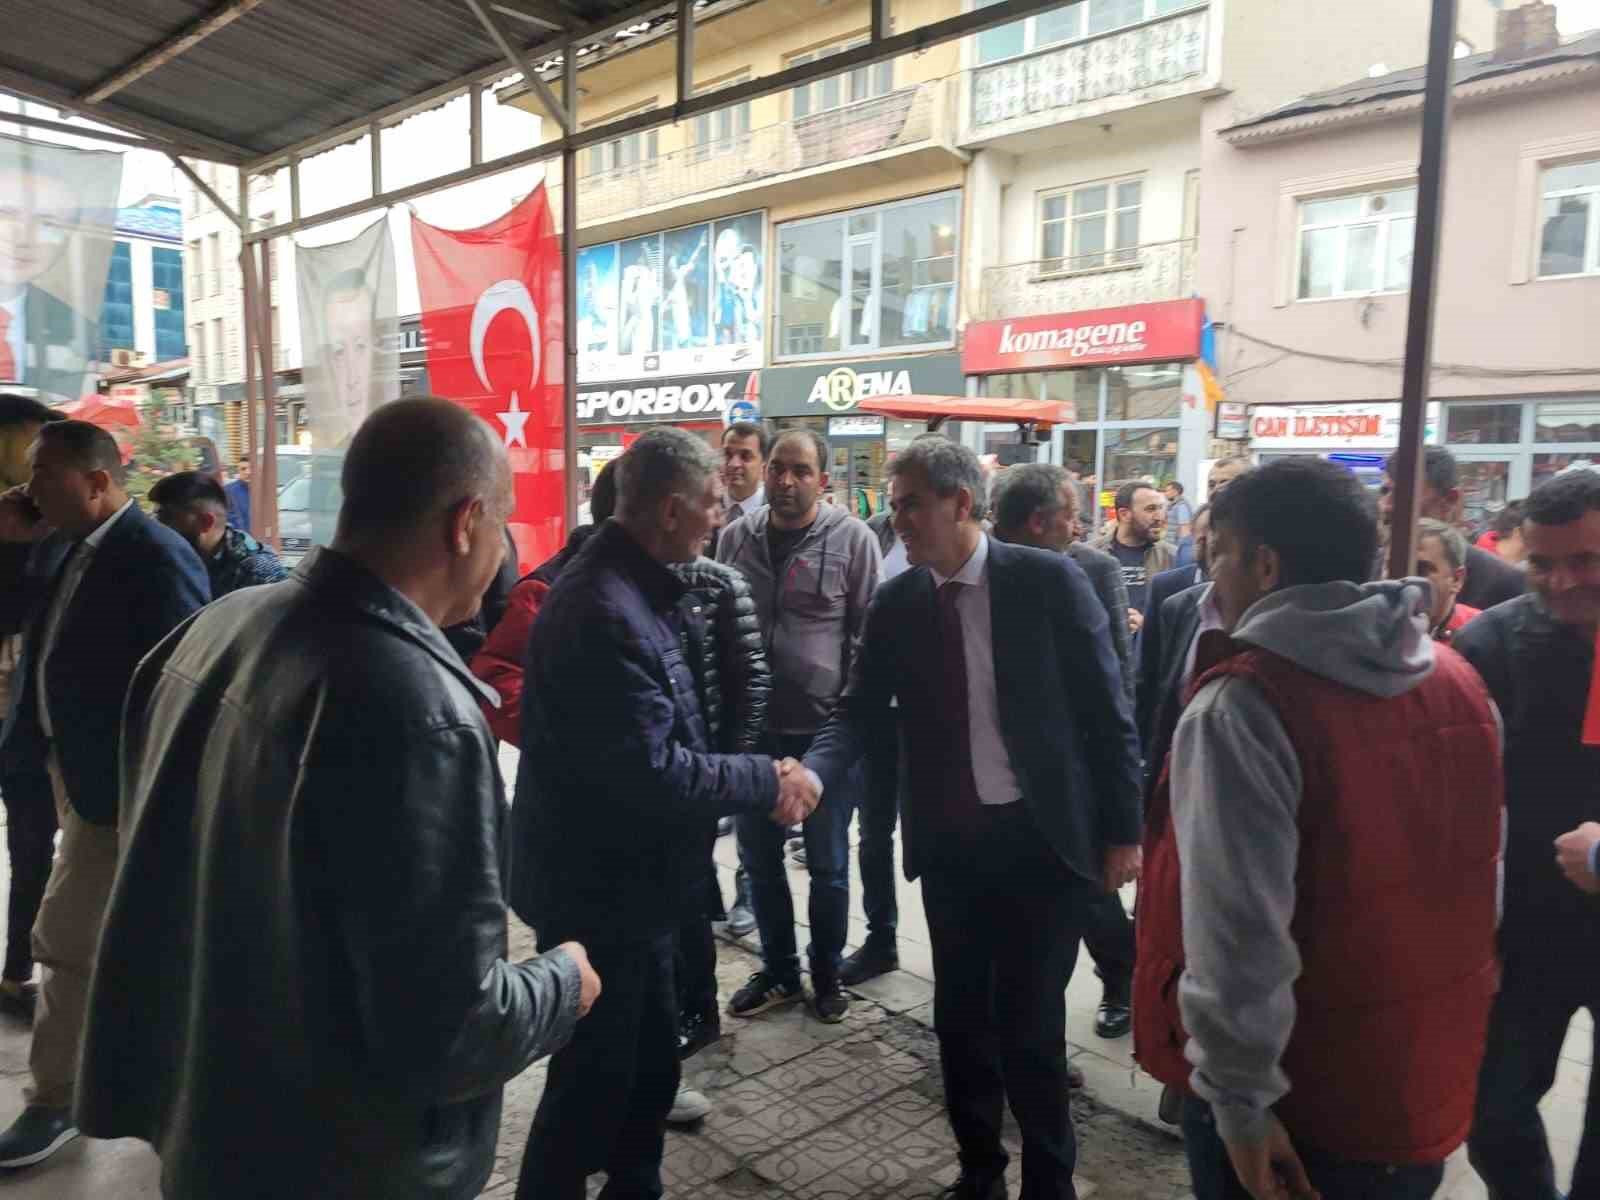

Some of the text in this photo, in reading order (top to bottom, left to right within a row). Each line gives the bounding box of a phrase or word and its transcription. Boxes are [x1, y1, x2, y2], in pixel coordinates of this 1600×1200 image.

[999, 320, 1146, 357] komagene
[576, 381, 736, 418] SPORBOX
[807, 367, 913, 411] ARENA
[1254, 415, 1288, 437] CAN
